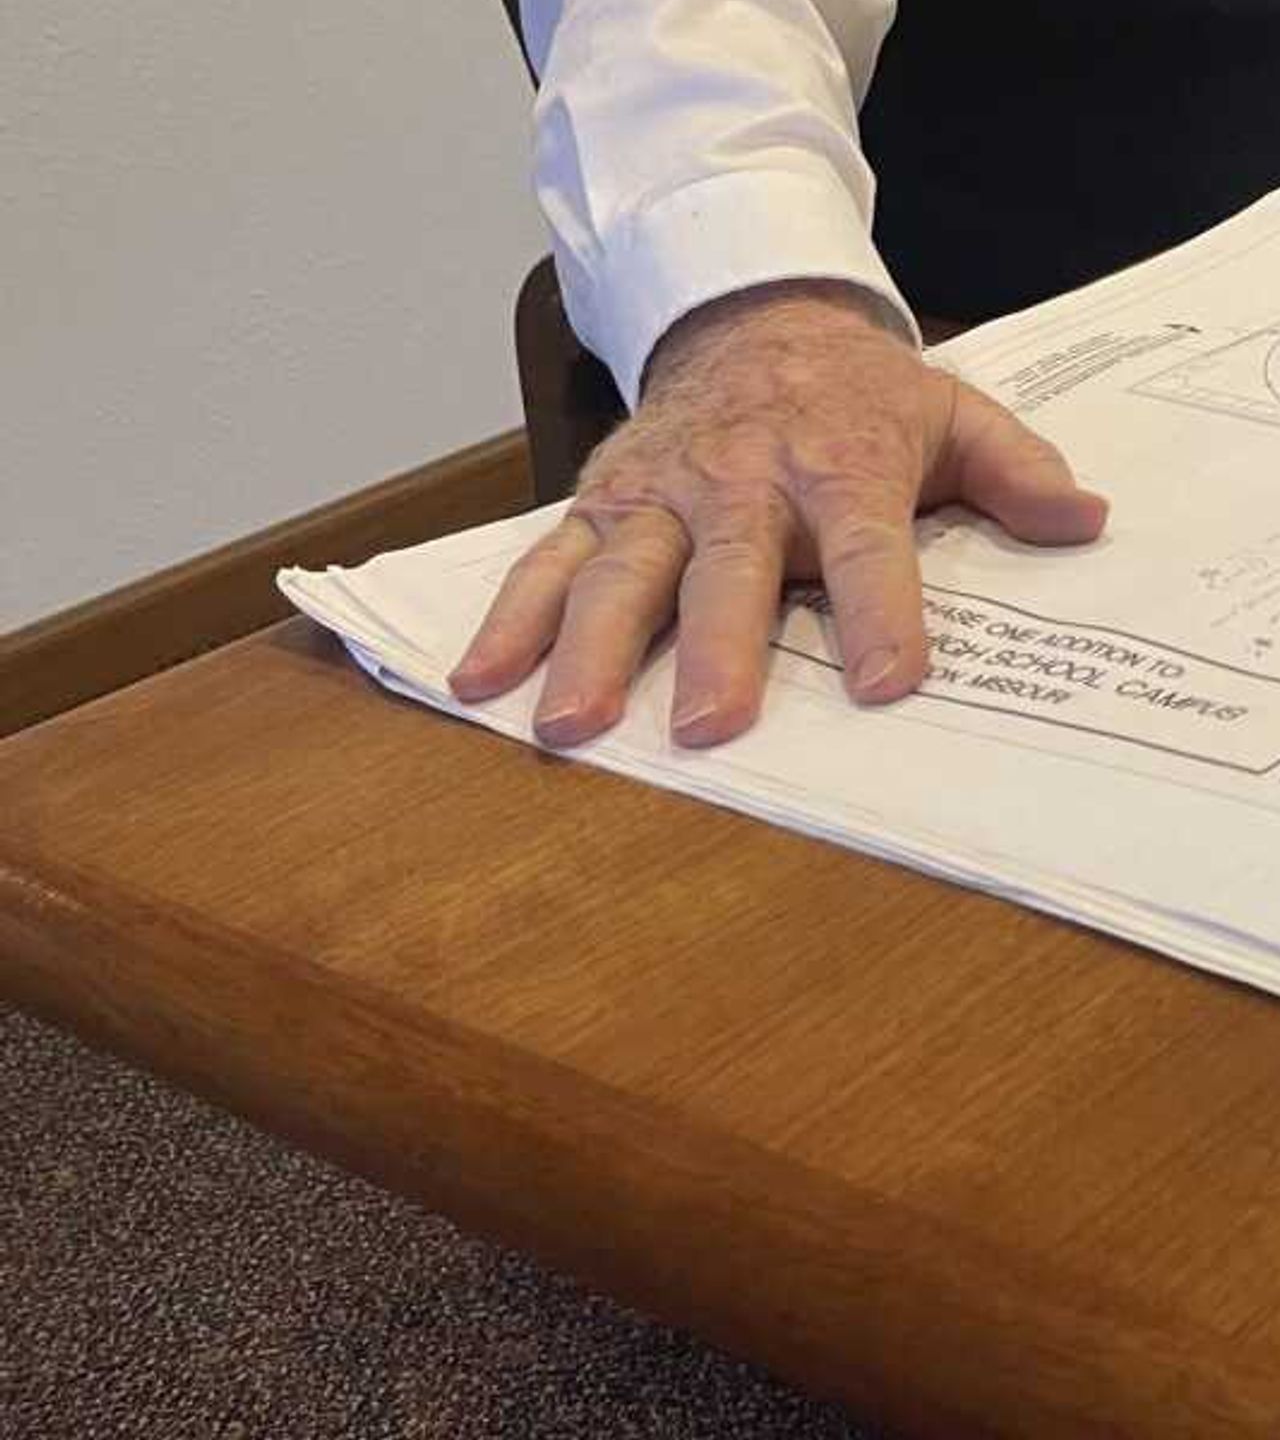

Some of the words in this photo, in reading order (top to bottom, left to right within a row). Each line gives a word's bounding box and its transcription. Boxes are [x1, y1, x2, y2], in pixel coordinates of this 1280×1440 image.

[986, 622, 1043, 643] ONE
[1033, 633, 1147, 667] ADDITION
[1145, 659, 1185, 679] TO
[983, 649, 1107, 691] SCHOOL
[1115, 679, 1249, 721] CAMPUS
